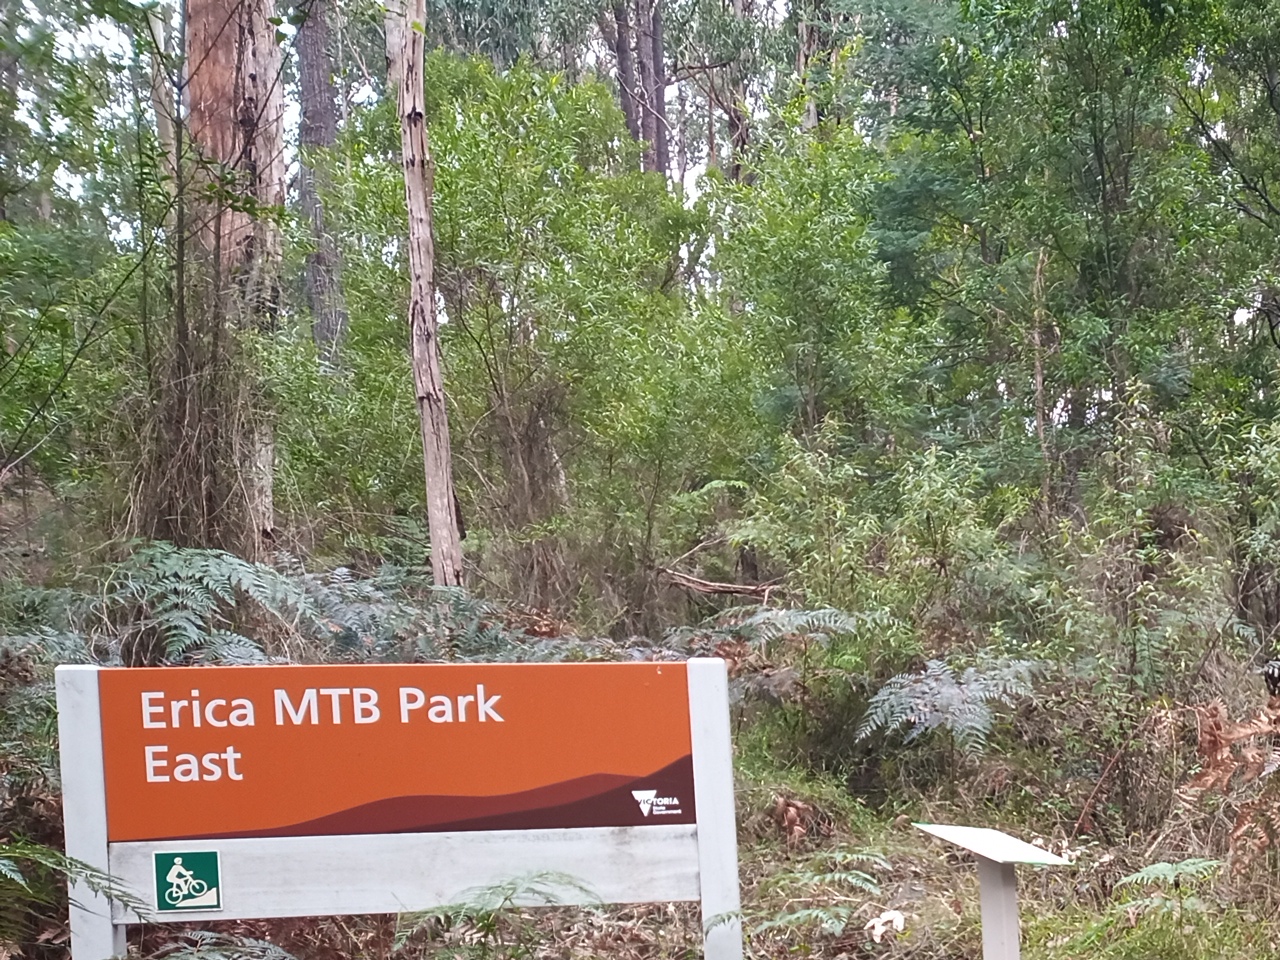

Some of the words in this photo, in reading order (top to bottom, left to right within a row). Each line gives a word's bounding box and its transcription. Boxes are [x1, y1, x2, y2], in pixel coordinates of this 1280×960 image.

[140, 690, 255, 729] Erica
[273, 687, 381, 726] MTB
[398, 683, 505, 724] Park
[144, 745, 244, 783] East
[638, 797, 680, 806] VICTORIA
